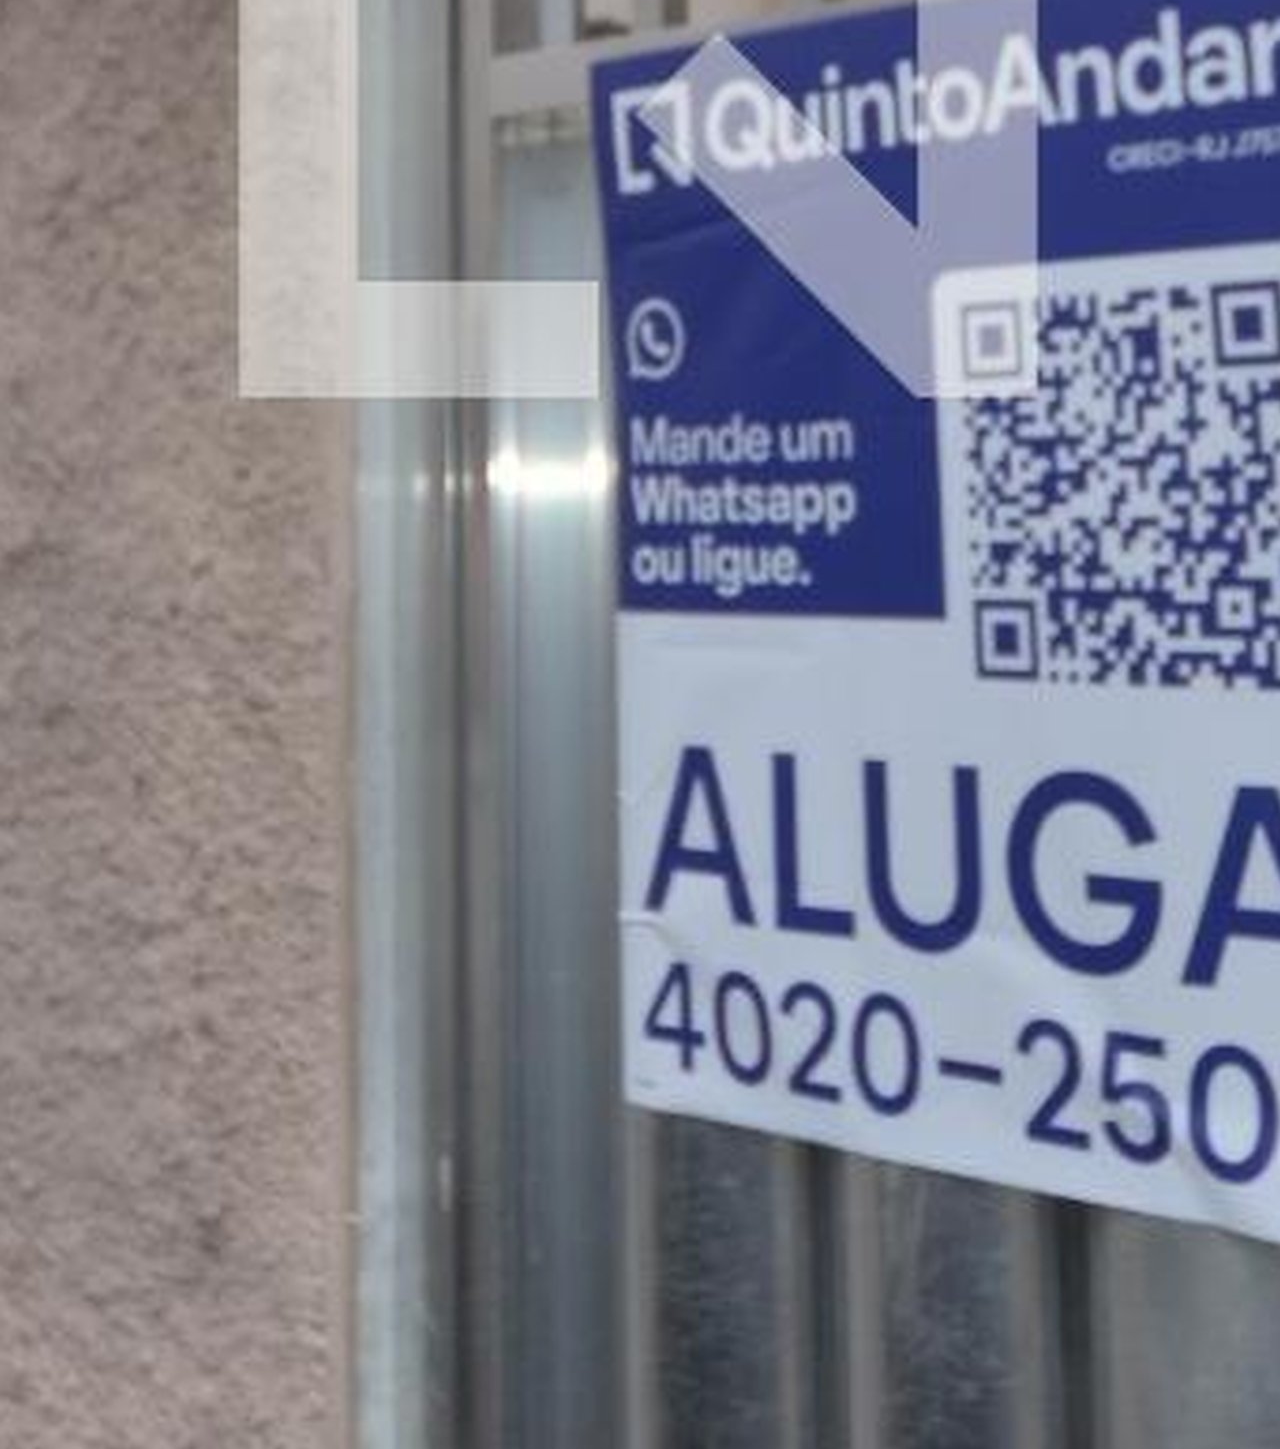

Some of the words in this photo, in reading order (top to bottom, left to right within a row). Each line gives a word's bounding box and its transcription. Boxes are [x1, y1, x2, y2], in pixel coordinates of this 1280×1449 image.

[630, 412, 771, 465] Mande
[779, 418, 853, 462] um
[630, 474, 857, 536] Whatsapp
[632, 545, 686, 585] ou
[691, 532, 813, 598] ligue.
